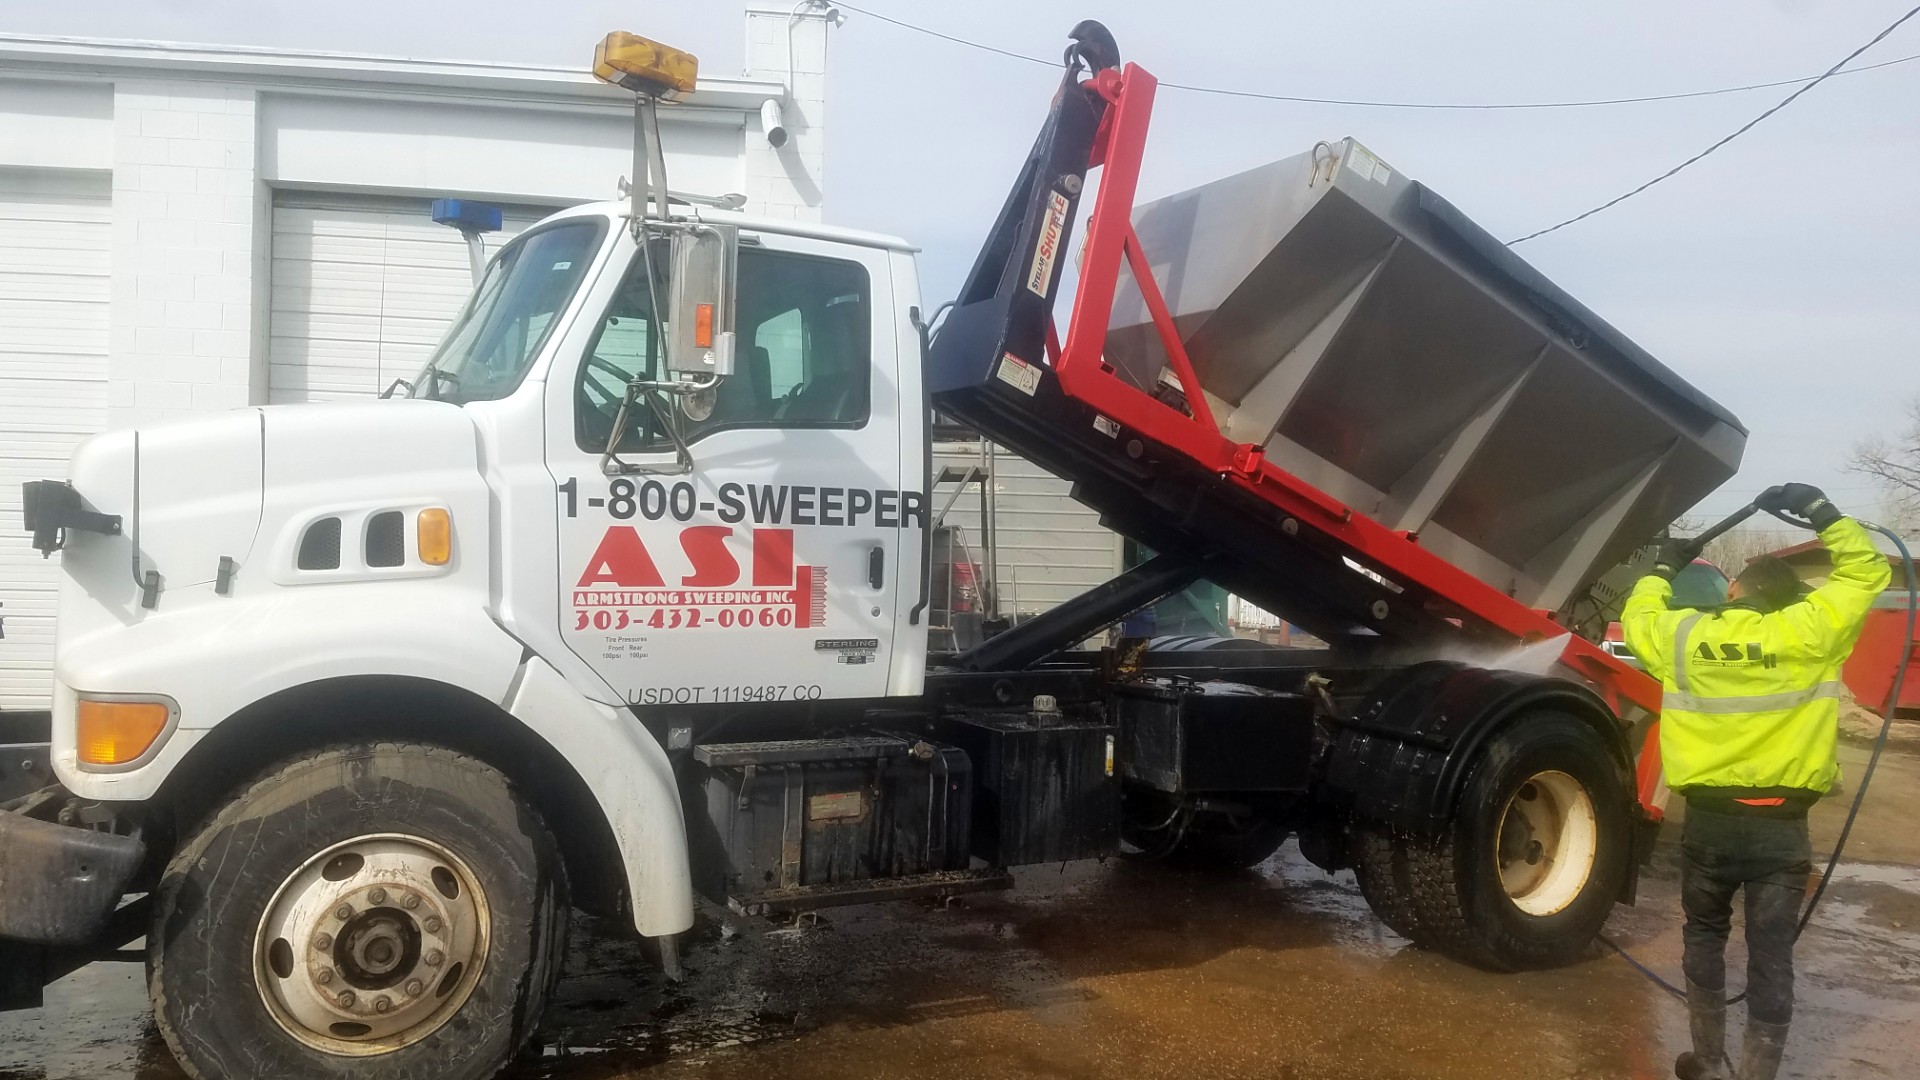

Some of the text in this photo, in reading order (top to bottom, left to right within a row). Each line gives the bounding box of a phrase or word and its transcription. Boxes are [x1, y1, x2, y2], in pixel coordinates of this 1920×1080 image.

[1031, 256, 1046, 290] STELLAR
[559, 477, 923, 529] 1-800-SWEEPER
[576, 526, 794, 588] ASI
[575, 591, 793, 605] ARMSTRONG SWEEPING INC.
[574, 608, 792, 631] 303-432-0060
[816, 640, 877, 648] STERLING
[628, 685, 822, 705] USDOT 1119487 CO
